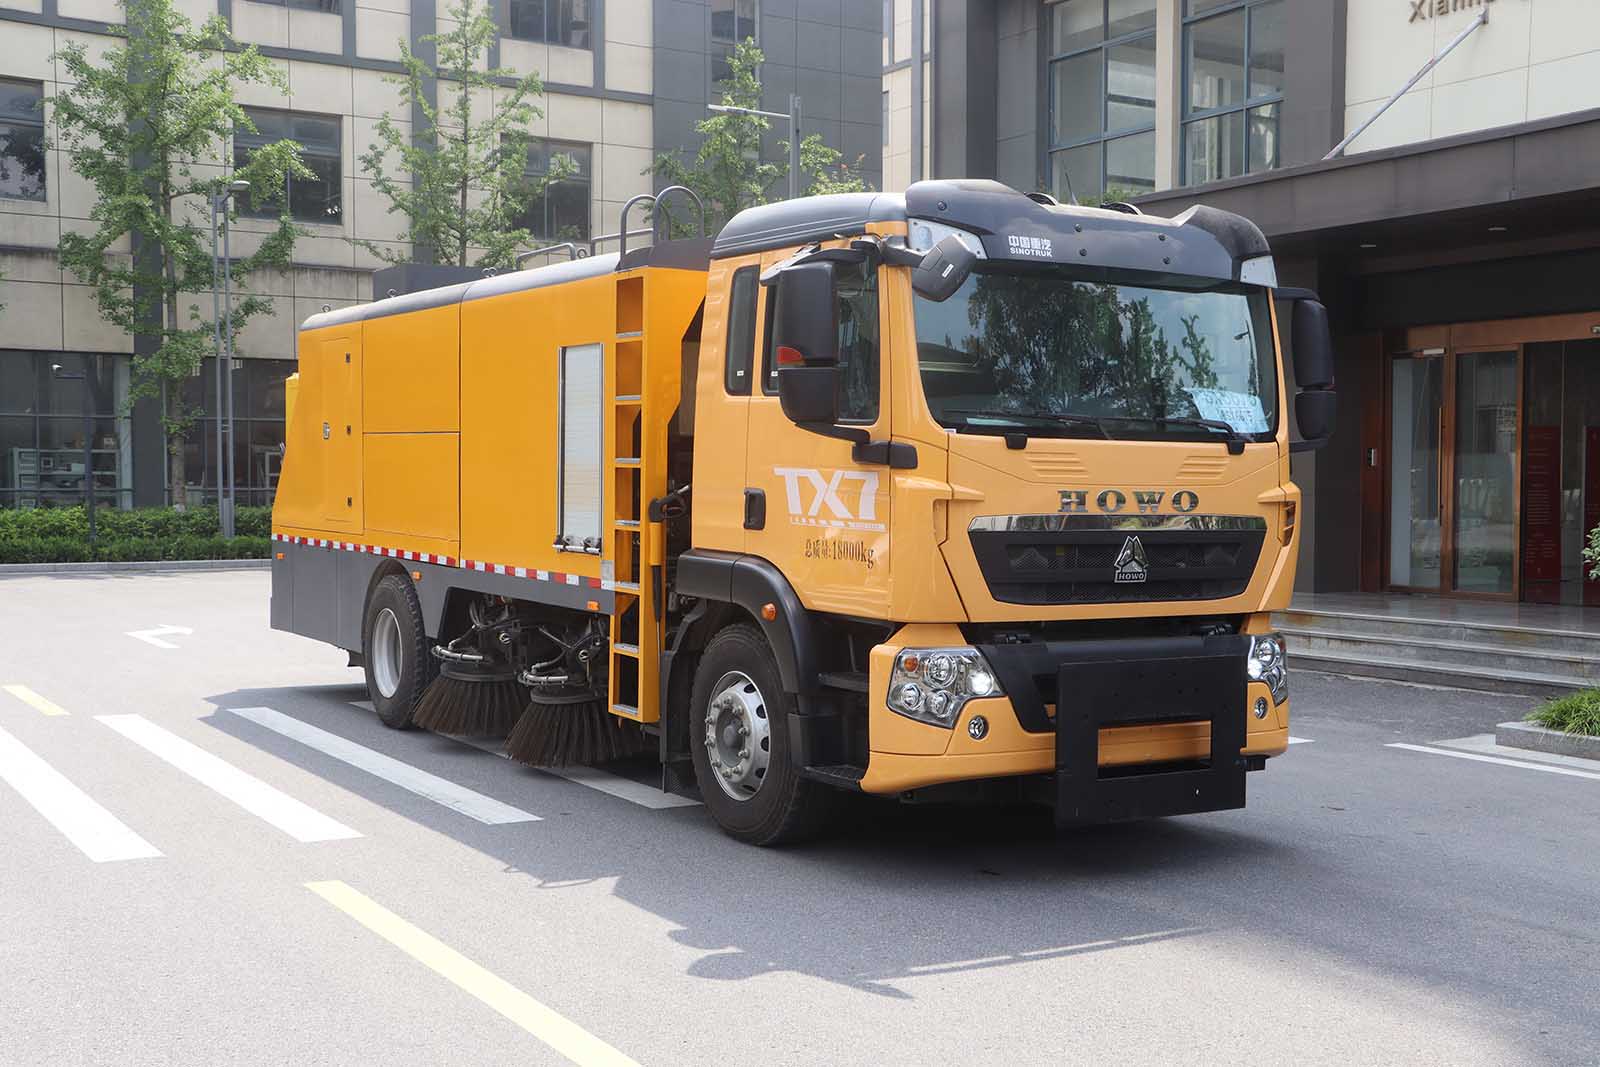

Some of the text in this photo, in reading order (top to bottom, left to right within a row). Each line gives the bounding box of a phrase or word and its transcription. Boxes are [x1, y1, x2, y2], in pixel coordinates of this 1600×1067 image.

[1008, 235, 1051, 250] 中国重汽
[1010, 247, 1052, 257] SINOTRUK
[773, 467, 879, 520] TX7
[1057, 489, 1199, 513] HOWO
